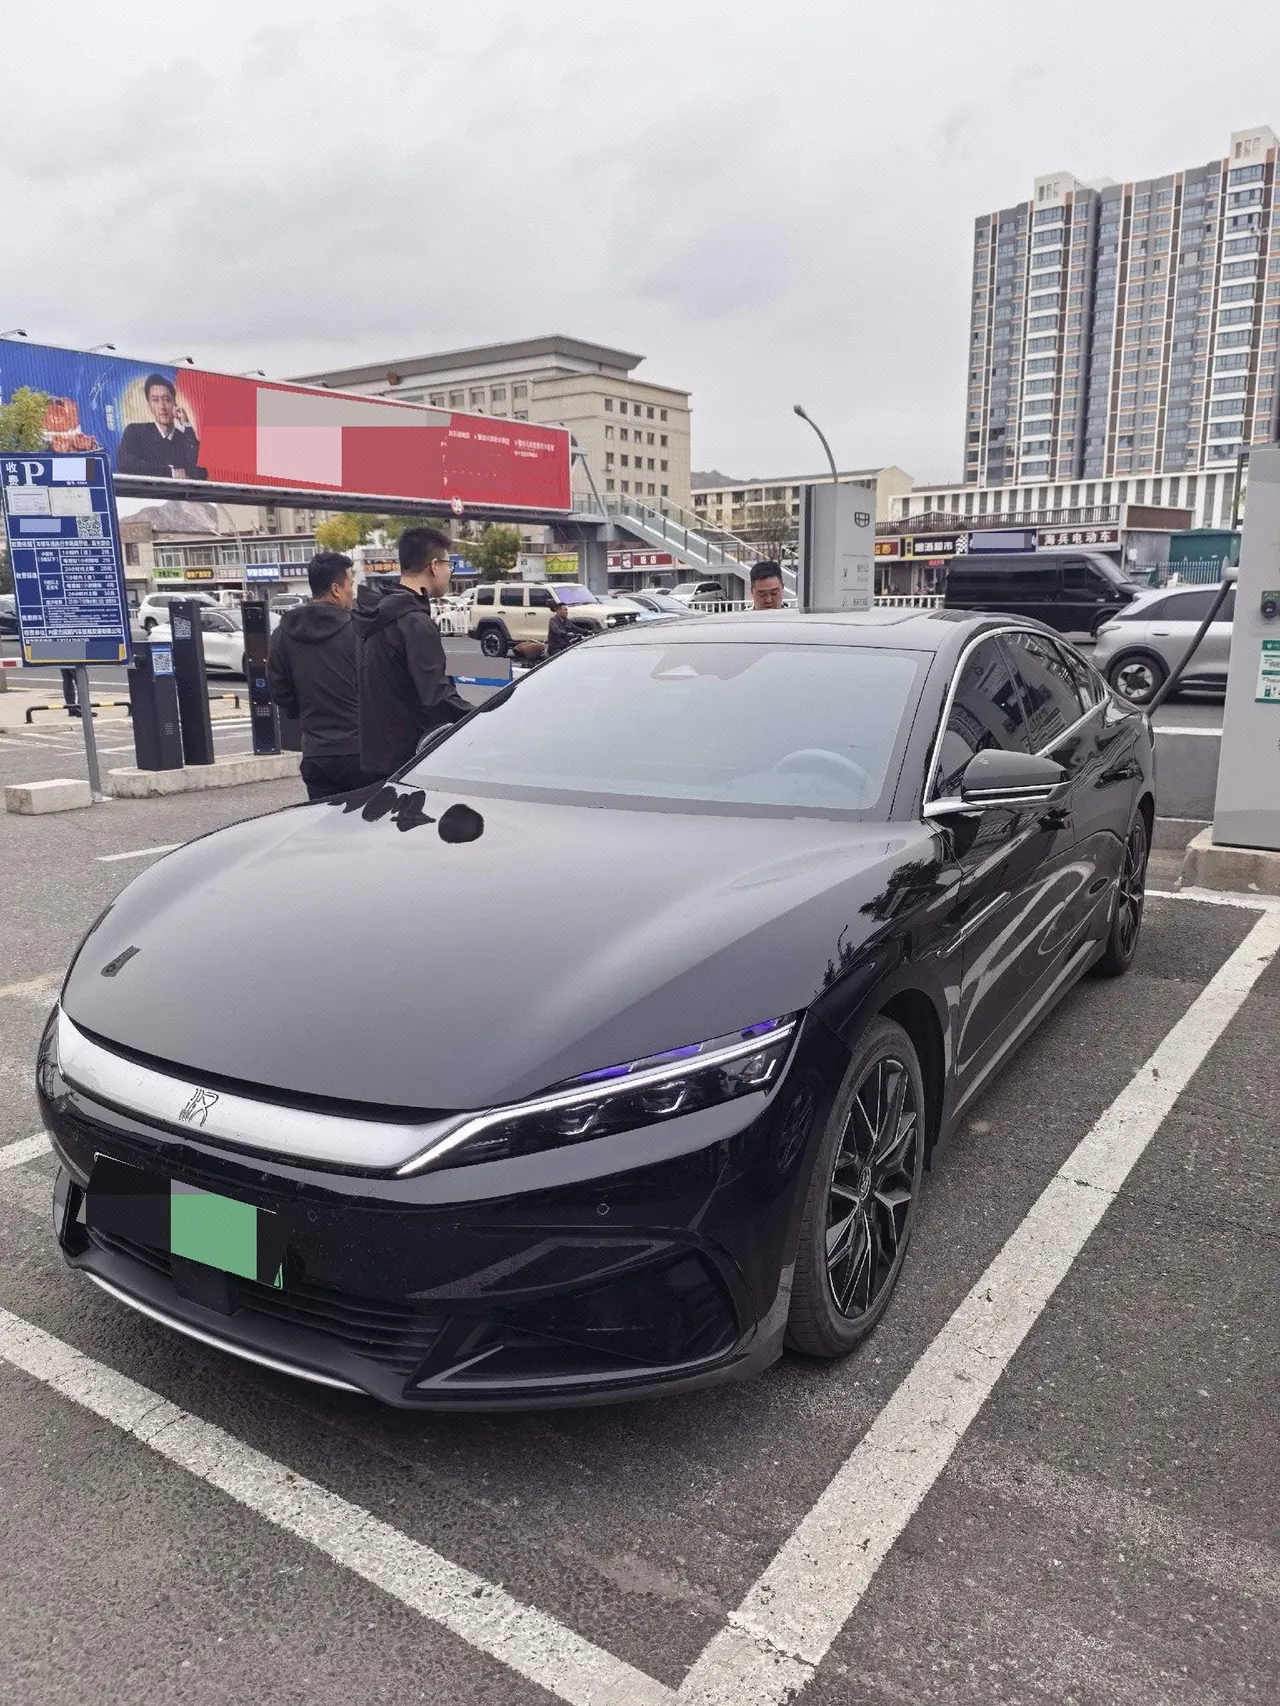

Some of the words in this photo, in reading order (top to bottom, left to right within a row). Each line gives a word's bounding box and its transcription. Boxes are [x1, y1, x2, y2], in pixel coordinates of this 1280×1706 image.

[5, 461, 19, 486] 收费
[20, 461, 45, 486] P
[1044, 531, 1111, 546] 海兵电动车
